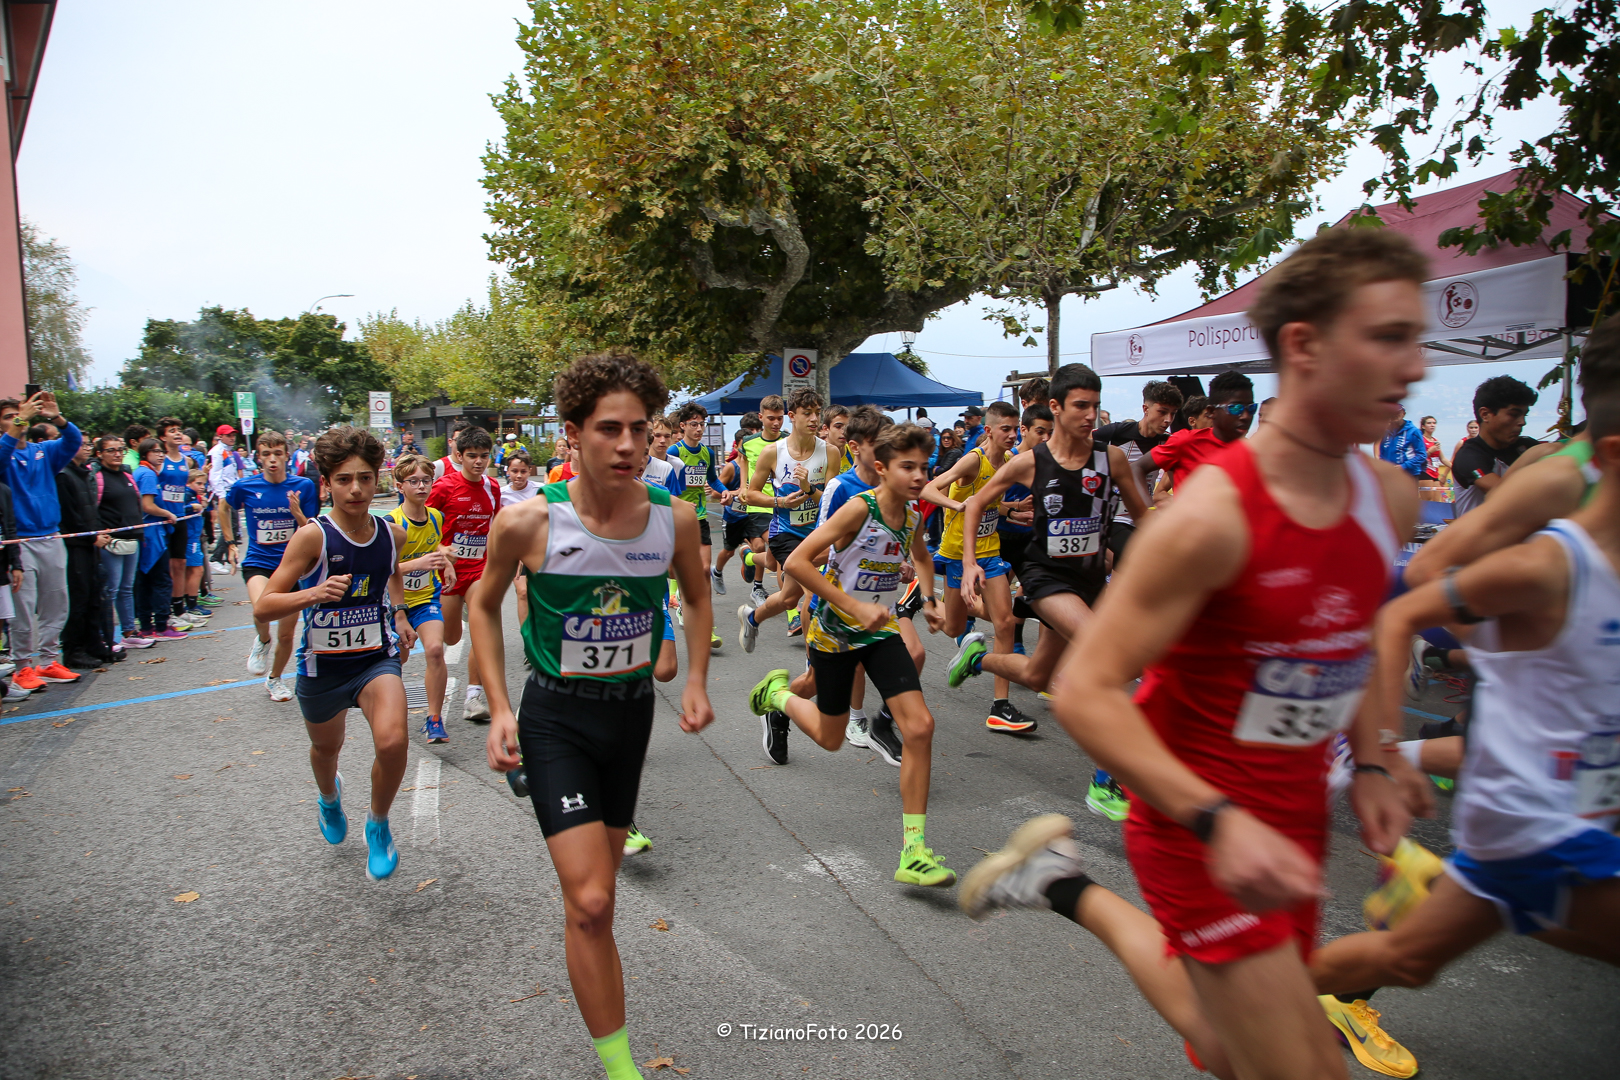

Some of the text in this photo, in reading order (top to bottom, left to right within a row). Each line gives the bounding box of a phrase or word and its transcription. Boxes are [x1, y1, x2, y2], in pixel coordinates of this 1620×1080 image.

[689, 476, 703, 484] 398
[798, 510, 816, 522] 415
[978, 523, 994, 535] 281
[266, 531, 287, 541] 245
[1060, 537, 1090, 554] 387
[457, 546, 478, 557] 314
[625, 552, 660, 560] GLOBAL
[405, 579, 421, 588] 40
[342, 607, 377, 616] CENTRO
[342, 612, 378, 620] SPORTIVO
[342, 616, 378, 625] ITALIANO
[606, 611, 654, 625] CENTRO
[606, 618, 652, 632] SPORTIVO
[606, 624, 652, 638] ITALIANO
[328, 628, 366, 647] 514
[582, 642, 634, 669] 371
